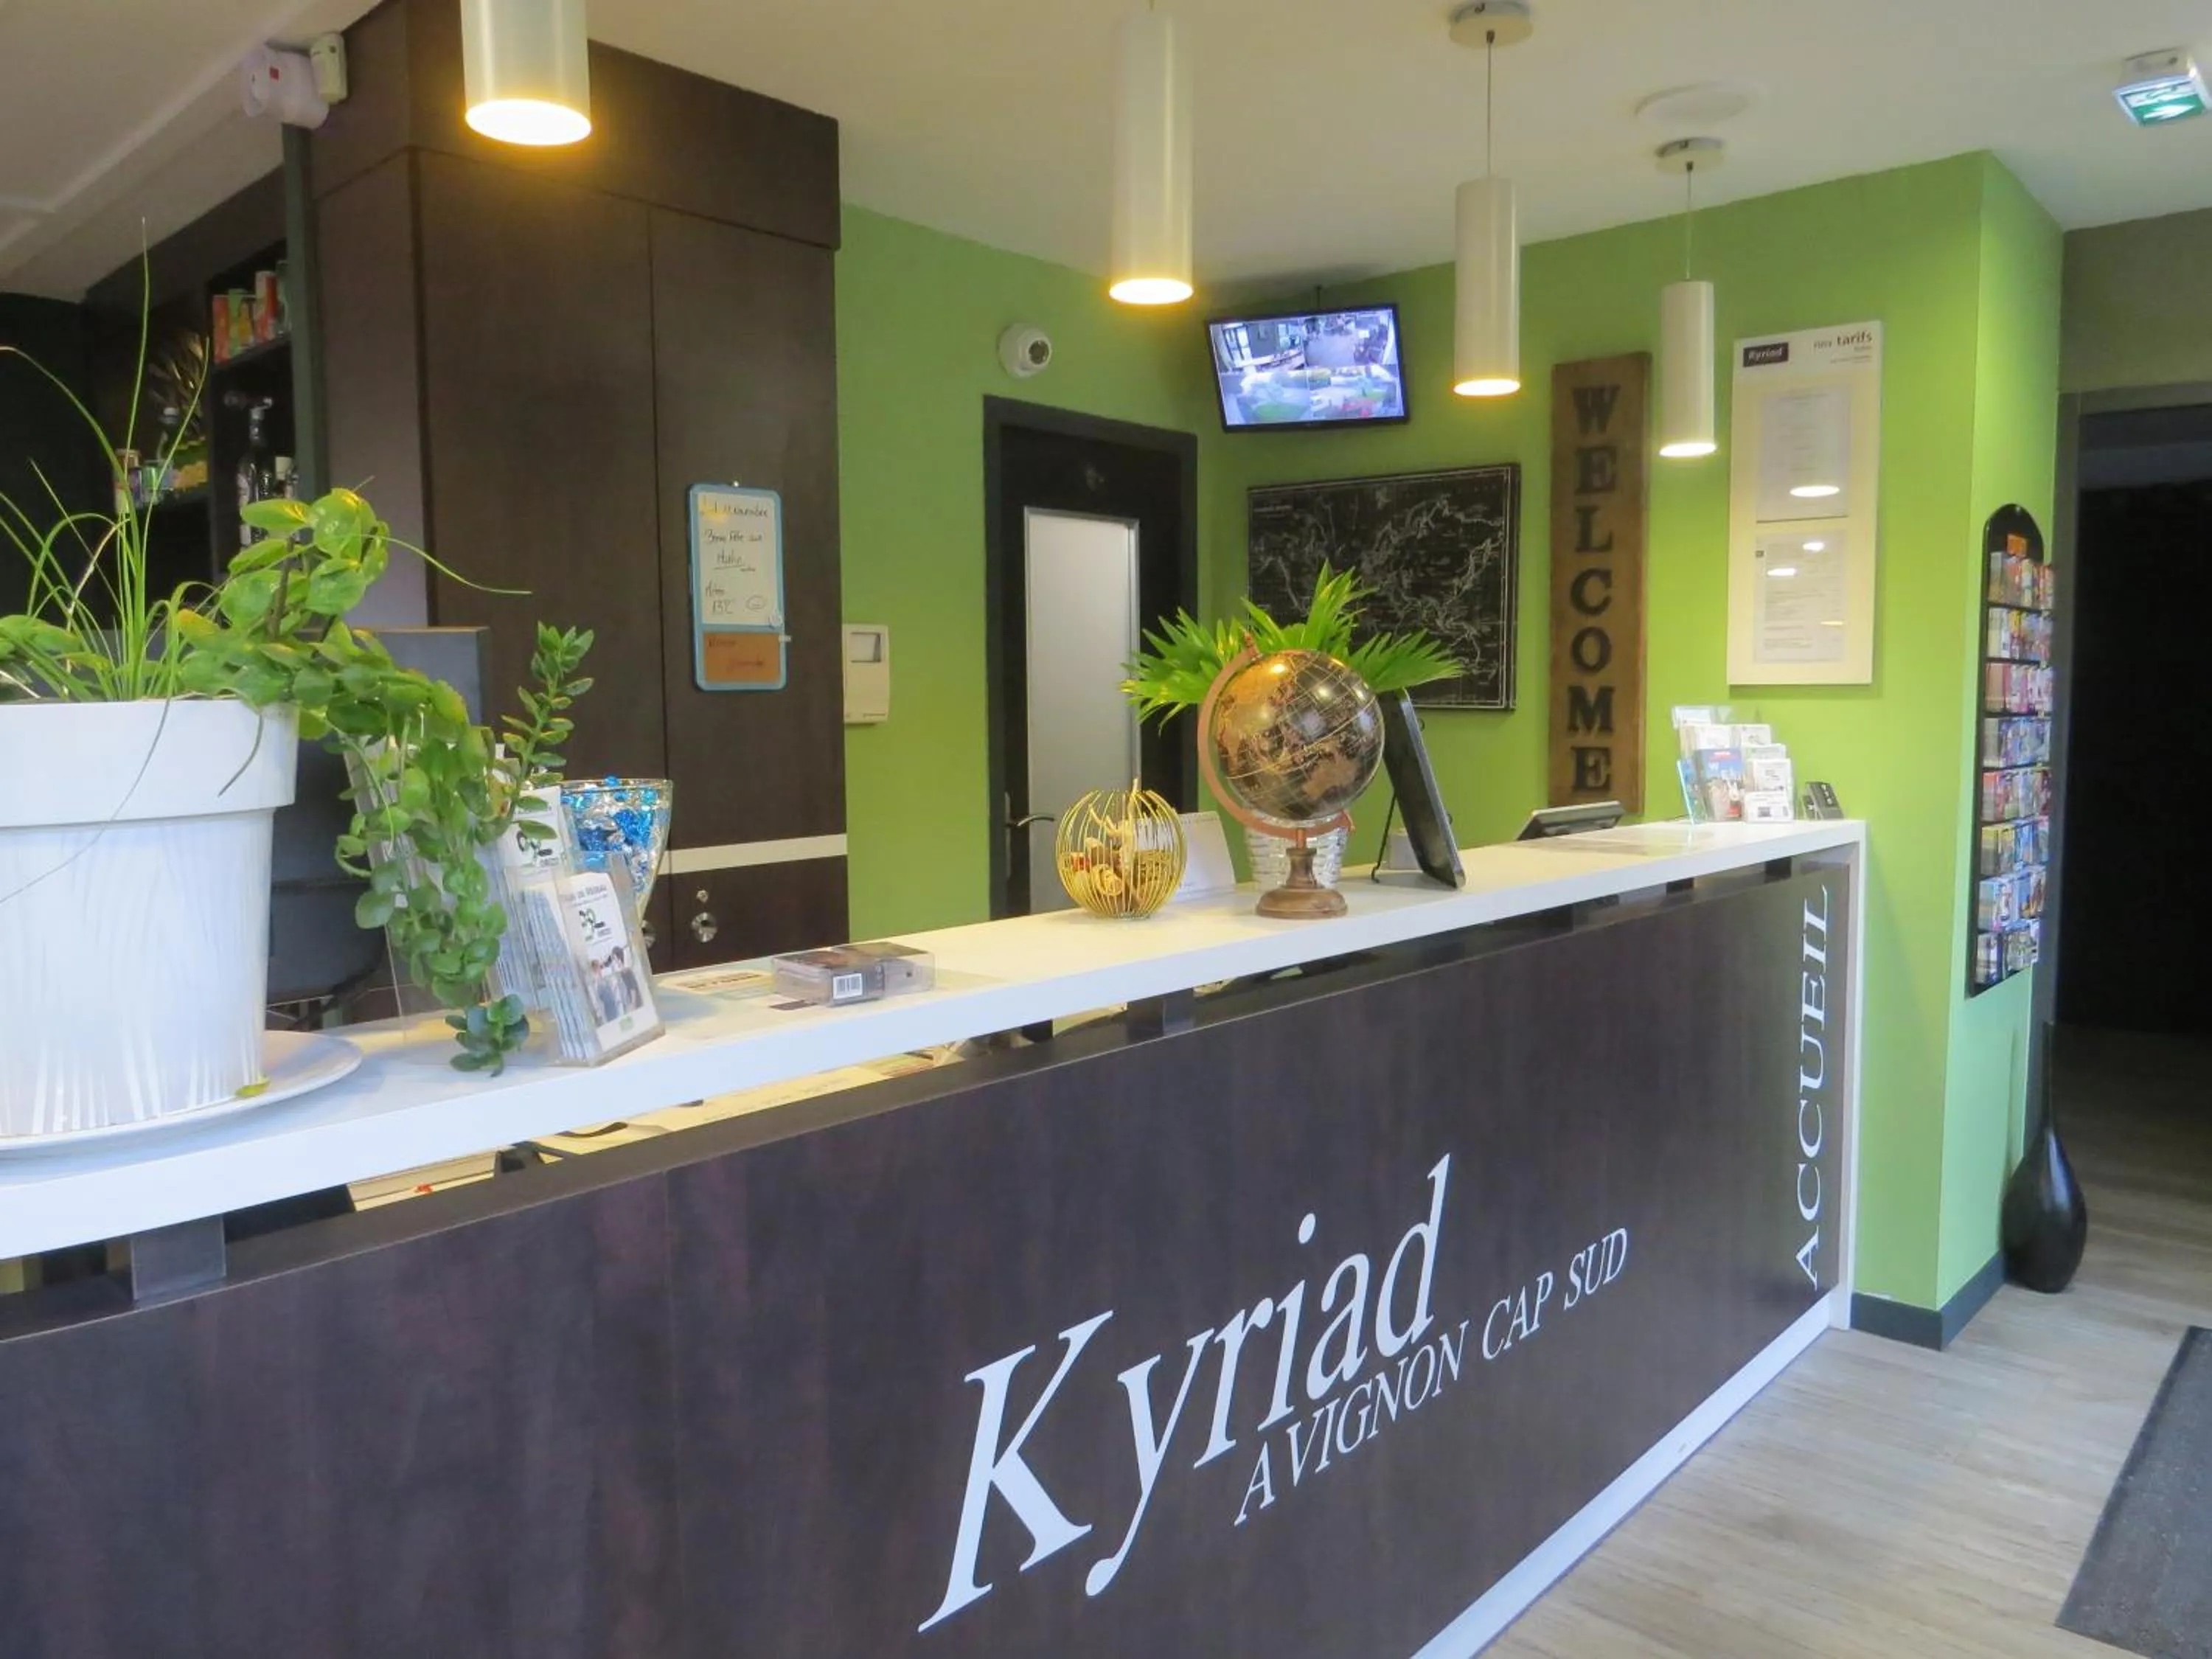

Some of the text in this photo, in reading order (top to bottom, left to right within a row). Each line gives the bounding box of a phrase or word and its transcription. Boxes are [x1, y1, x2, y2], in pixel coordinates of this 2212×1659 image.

[1837, 330, 1873, 347] tarifs
[1567, 383, 1621, 793] WELCOME
[1795, 883, 1829, 1291] ACCUEIL
[917, 1153, 1450, 1632] Kyriad
[1234, 1228, 1627, 1526] AVIGNON CAP SUD
